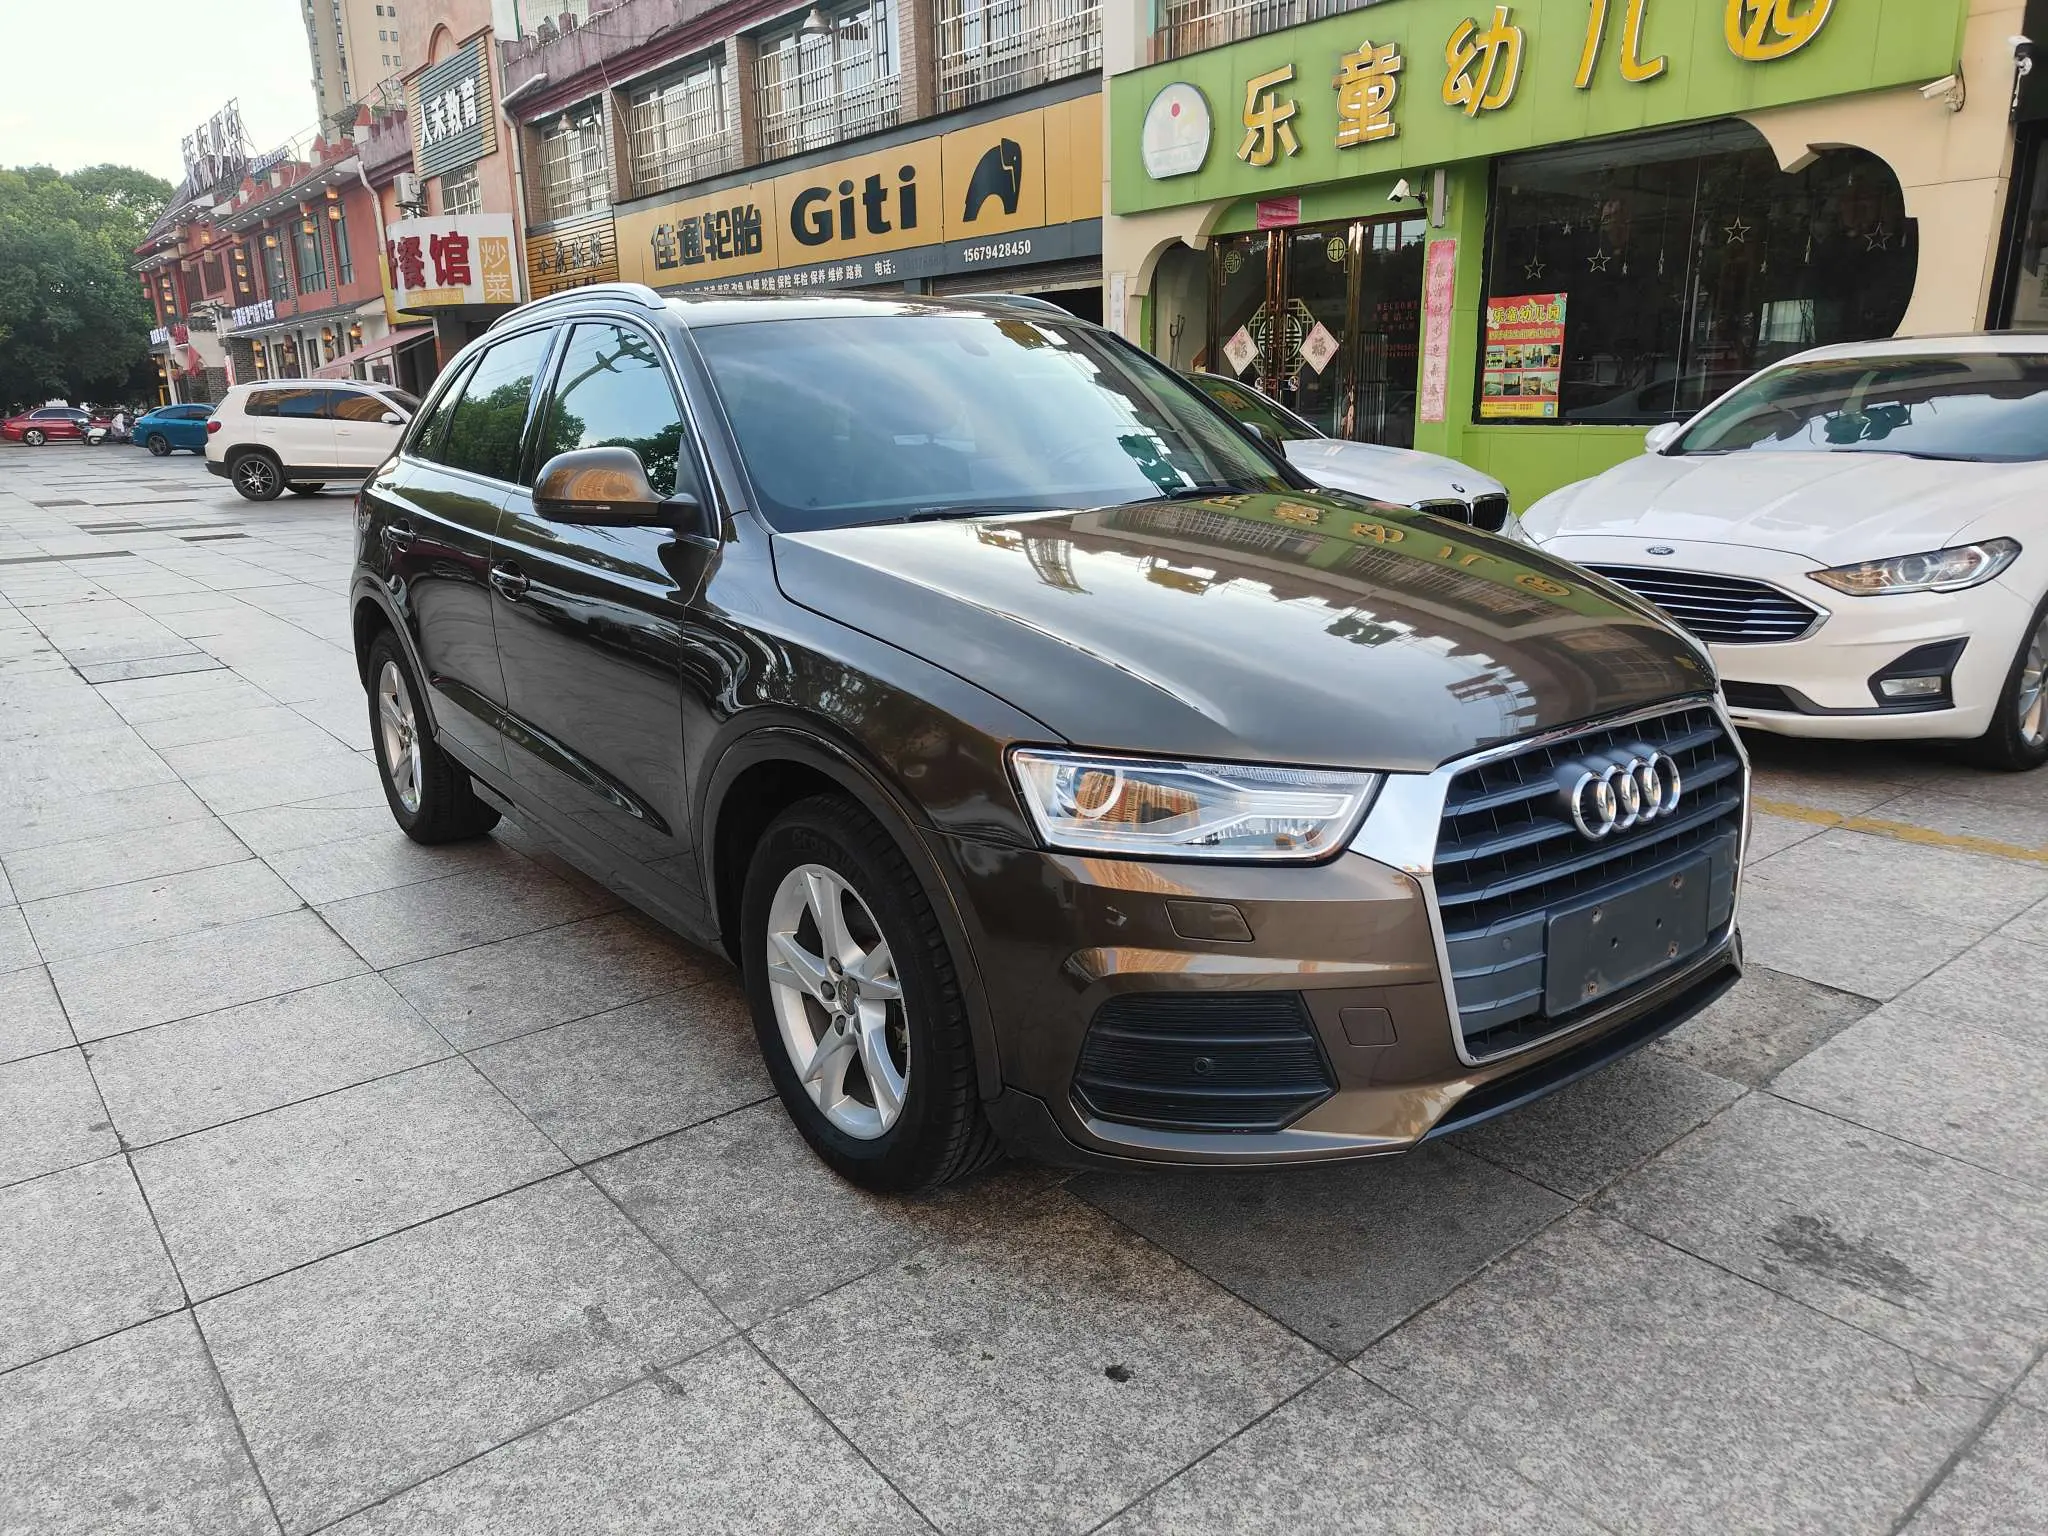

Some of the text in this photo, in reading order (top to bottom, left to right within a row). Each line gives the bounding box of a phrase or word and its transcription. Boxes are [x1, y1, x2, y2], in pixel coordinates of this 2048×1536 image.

[650, 203, 763, 271] 佳通轮胎
[790, 165, 917, 246] Giti
[481, 239, 511, 301] 炒菜
[810, 268, 826, 285] 保养
[828, 265, 844, 282] 维修
[963, 239, 1031, 263] 15679428450
